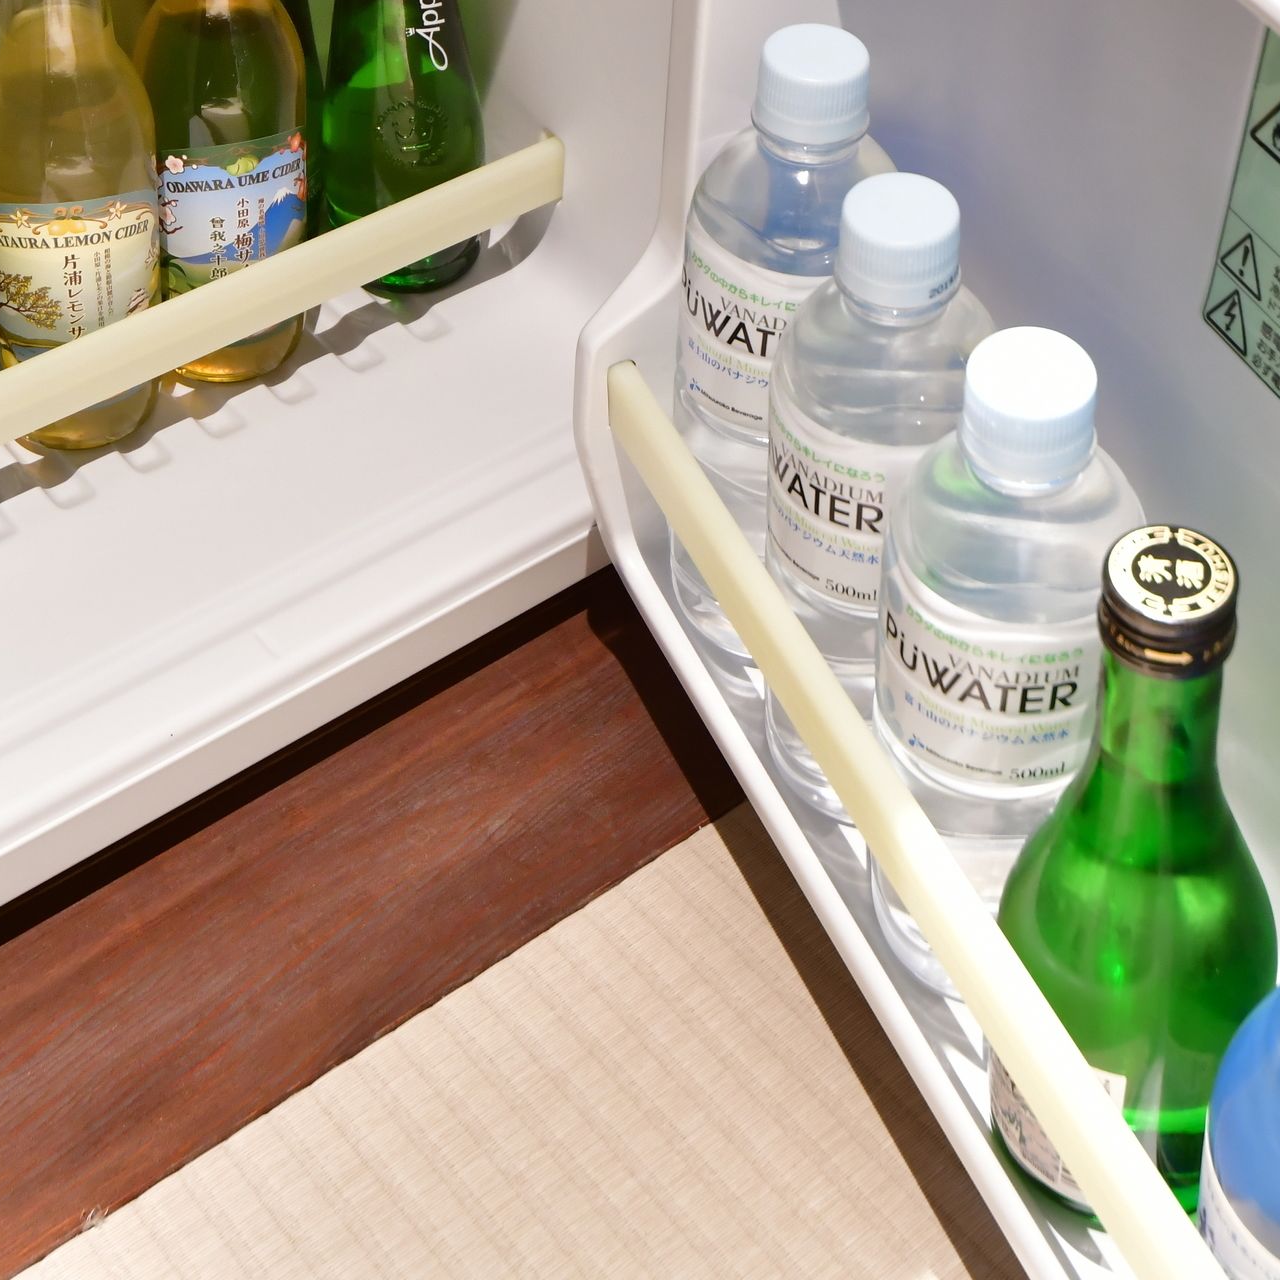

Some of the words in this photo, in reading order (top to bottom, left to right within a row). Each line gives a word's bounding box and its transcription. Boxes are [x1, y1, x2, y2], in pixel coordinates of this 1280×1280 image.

[166, 177, 236, 194] ODAWARA
[237, 169, 271, 188] UME
[271, 157, 302, 180] CIDER
[236, 197, 251, 229] 小田原
[52, 230, 114, 249] LEMON
[114, 218, 151, 241] CIDER
[234, 232, 255, 268] 梅サ
[781, 441, 884, 505] VANADIUM
[825, 578, 878, 602] 500ml
[948, 652, 1080, 684] VANADIUM
[1009, 761, 1066, 781] 500ml
